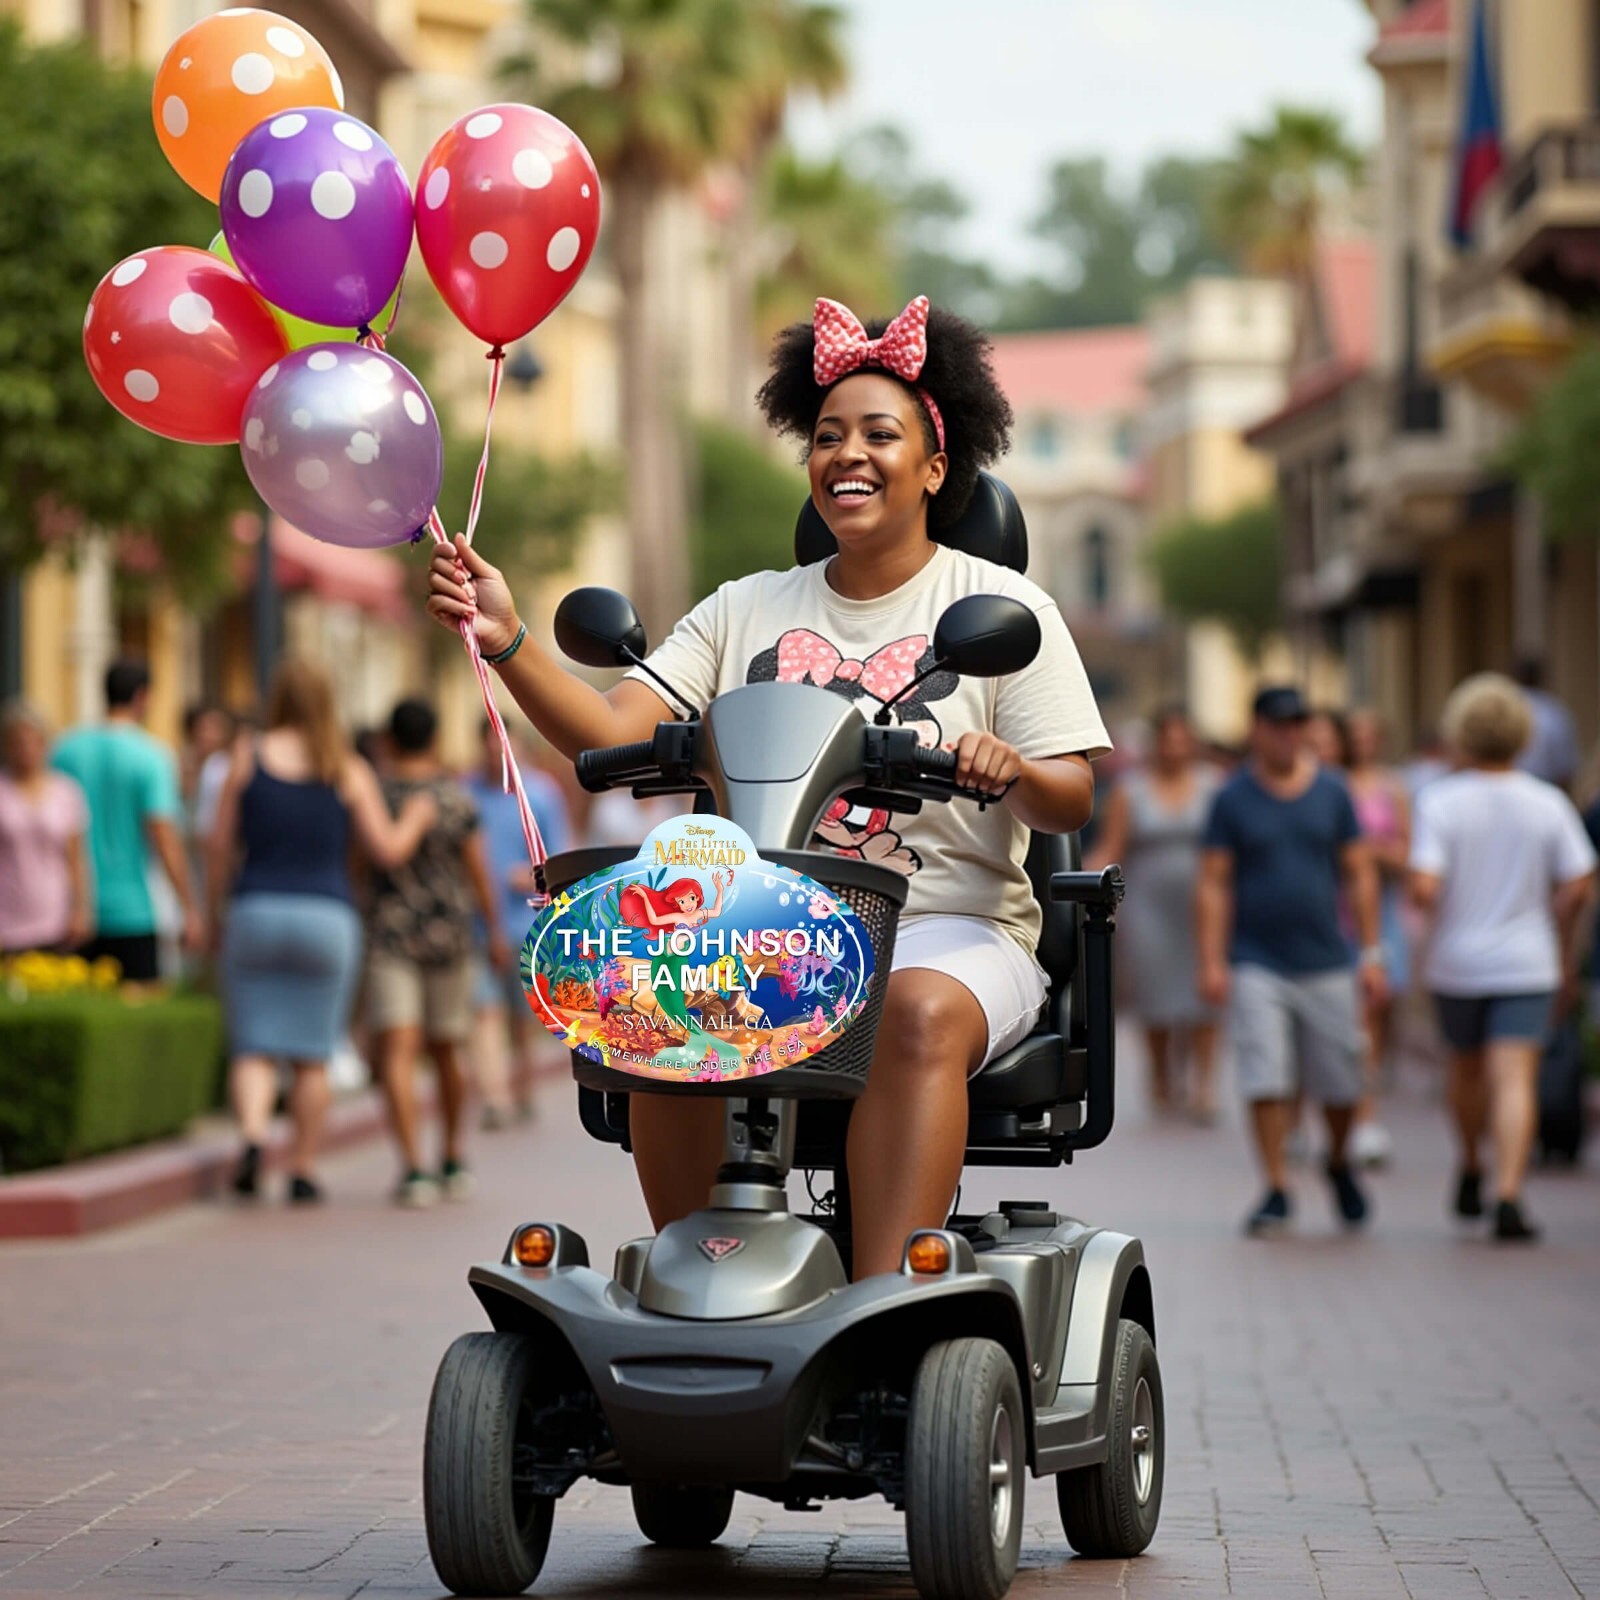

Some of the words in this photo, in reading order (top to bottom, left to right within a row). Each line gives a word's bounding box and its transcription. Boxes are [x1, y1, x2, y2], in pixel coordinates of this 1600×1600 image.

[679, 838, 697, 848] THE
[701, 838, 737, 849] LITTLE
[684, 824, 716, 838] Disney
[654, 840, 746, 870] MERMAID
[556, 929, 633, 957] THE
[647, 928, 840, 957] JOHNSON
[631, 963, 764, 992] FAMILY
[623, 1014, 738, 1033] SAVANNAH,
[744, 1014, 773, 1031] GA
[591, 1039, 682, 1071] SOMEWHERE
[689, 1060, 739, 1071] UNDER
[745, 1052, 772, 1066] THE
[778, 1039, 806, 1057] SEA
